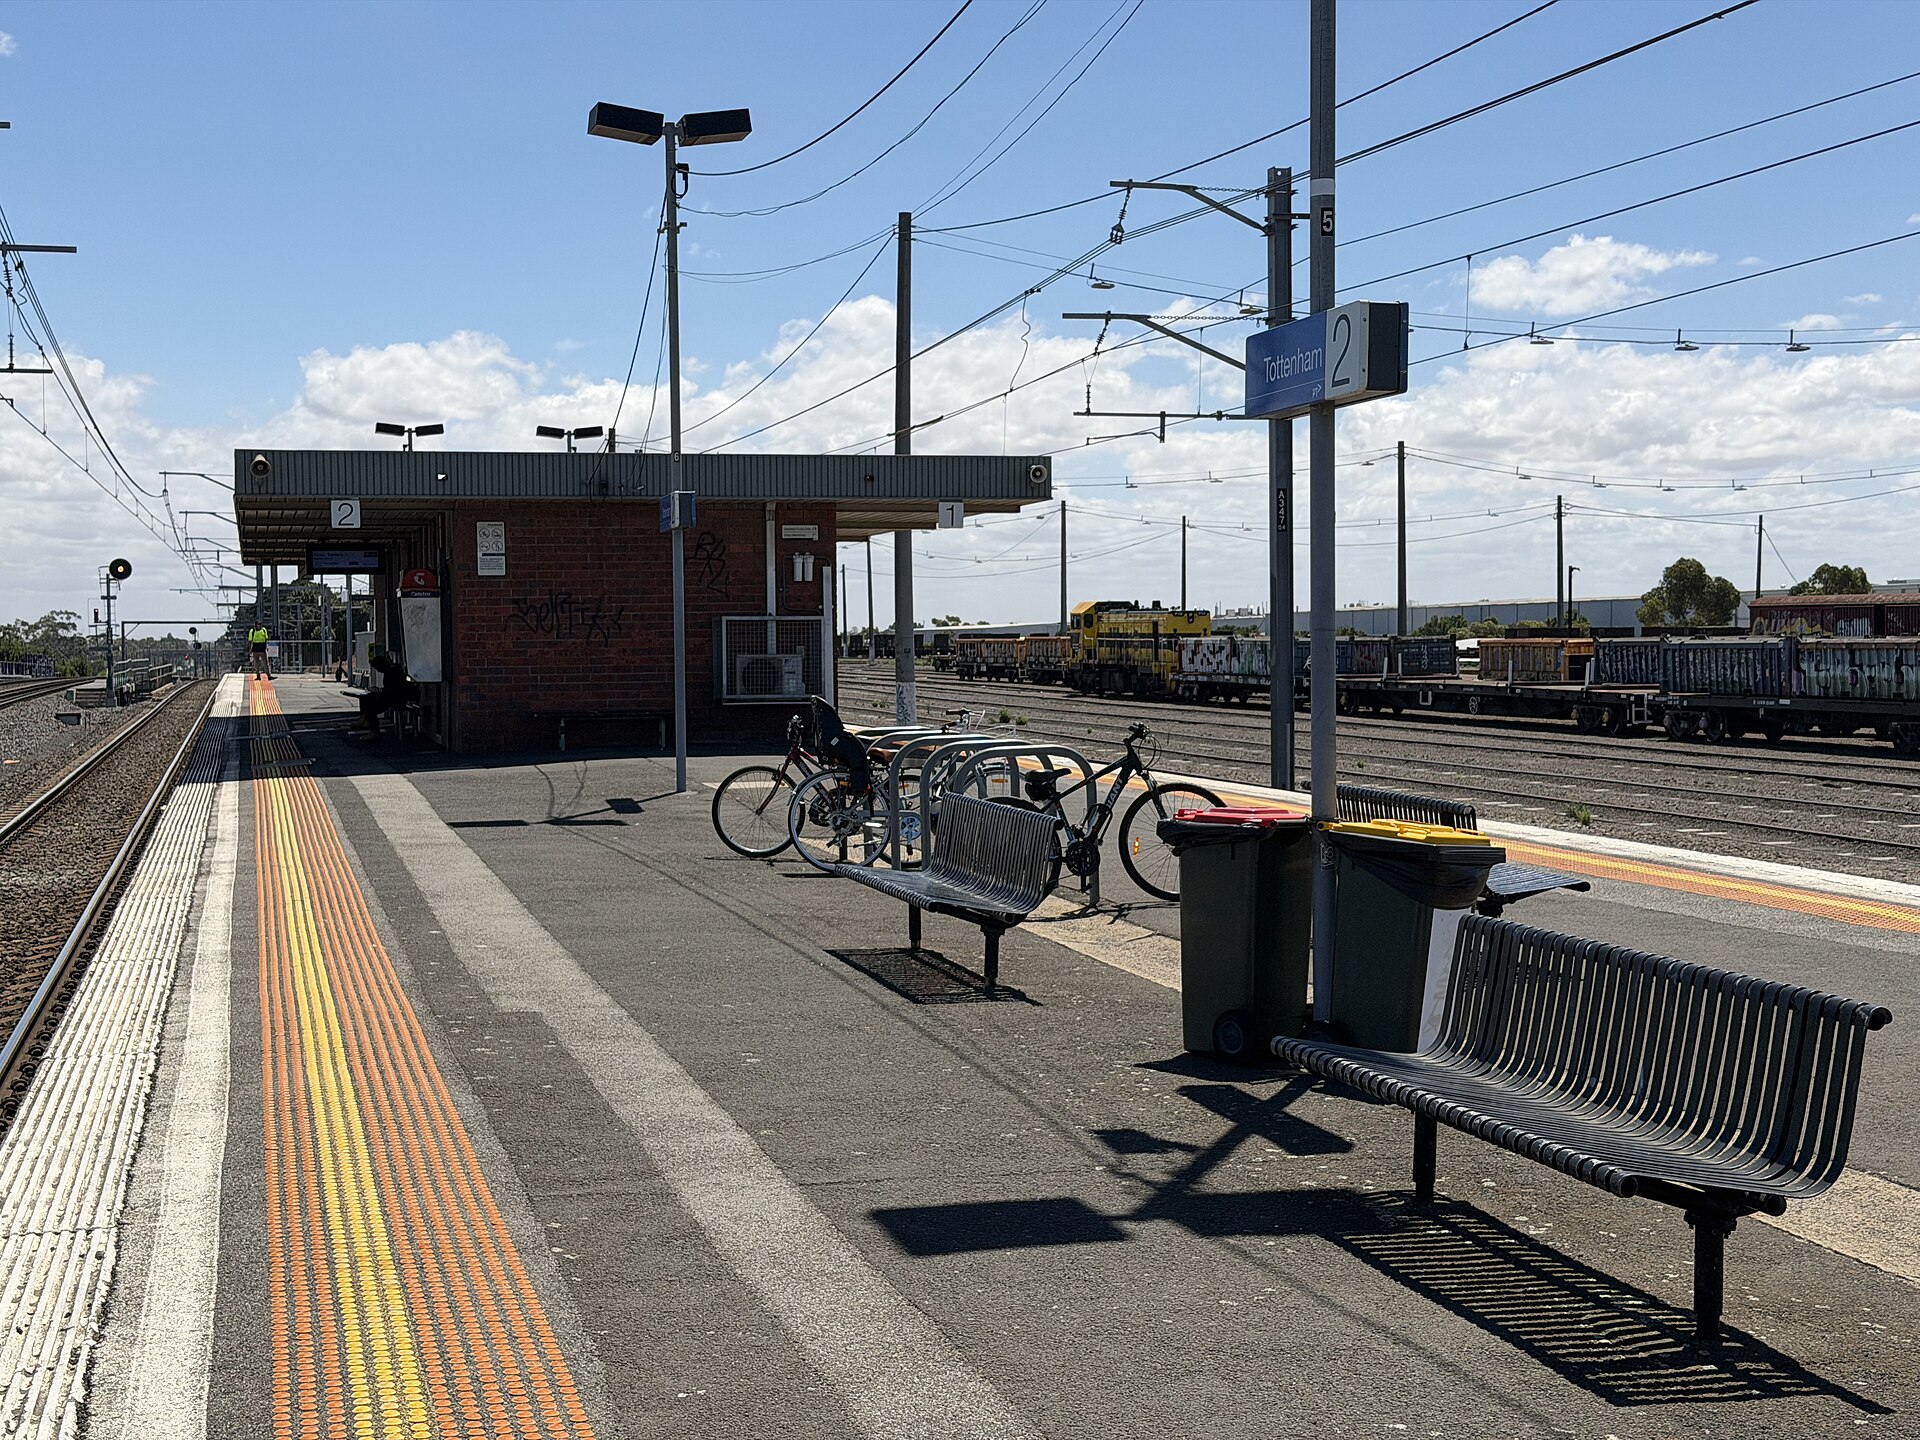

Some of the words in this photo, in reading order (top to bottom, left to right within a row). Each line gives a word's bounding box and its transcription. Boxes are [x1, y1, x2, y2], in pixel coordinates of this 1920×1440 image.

[1322, 210, 1333, 233] 5
[1331, 313, 1352, 389] 2
[1263, 347, 1323, 384] Tottenham
[674, 451, 680, 462] 6
[337, 502, 355, 527] 2
[945, 504, 955, 527] 1
